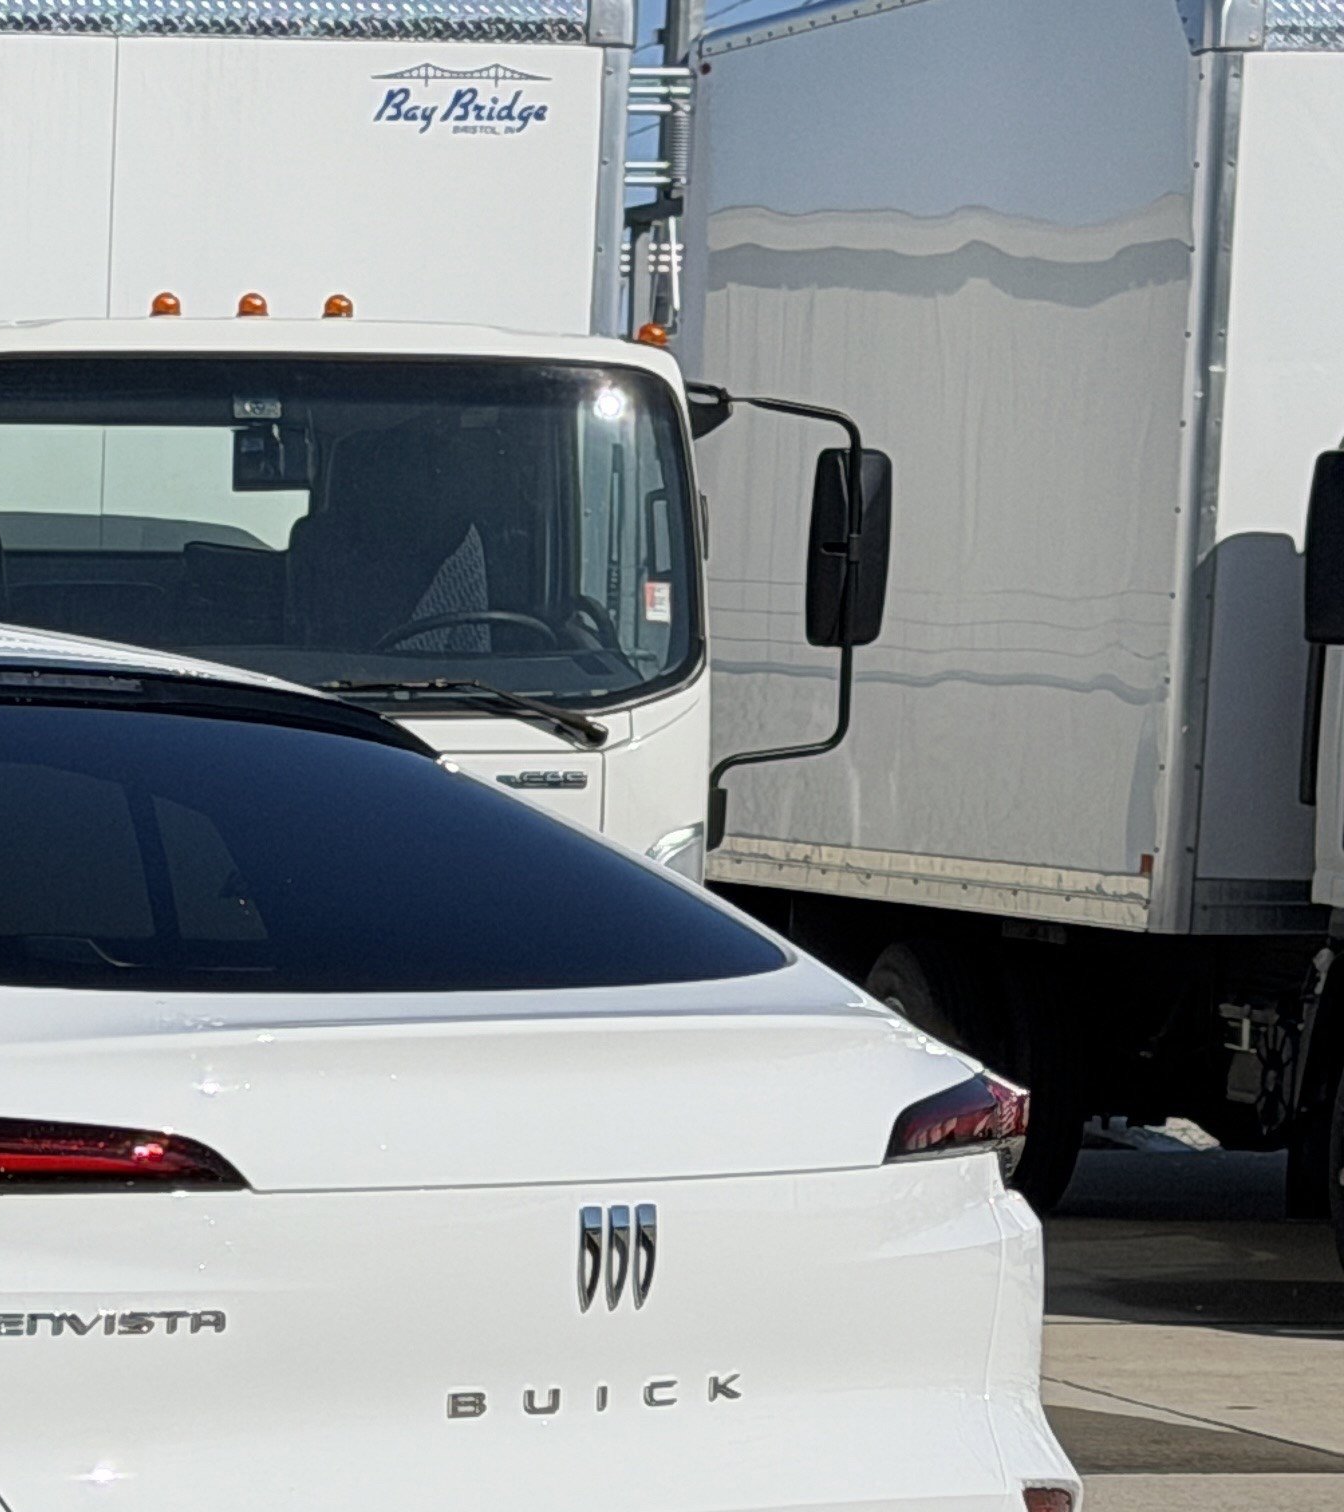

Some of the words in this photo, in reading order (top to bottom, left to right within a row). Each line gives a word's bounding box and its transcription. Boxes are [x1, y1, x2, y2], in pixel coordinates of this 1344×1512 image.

[373, 87, 438, 134] Bay
[440, 87, 548, 133] Bridge
[446, 1374, 742, 1419] BUICK
